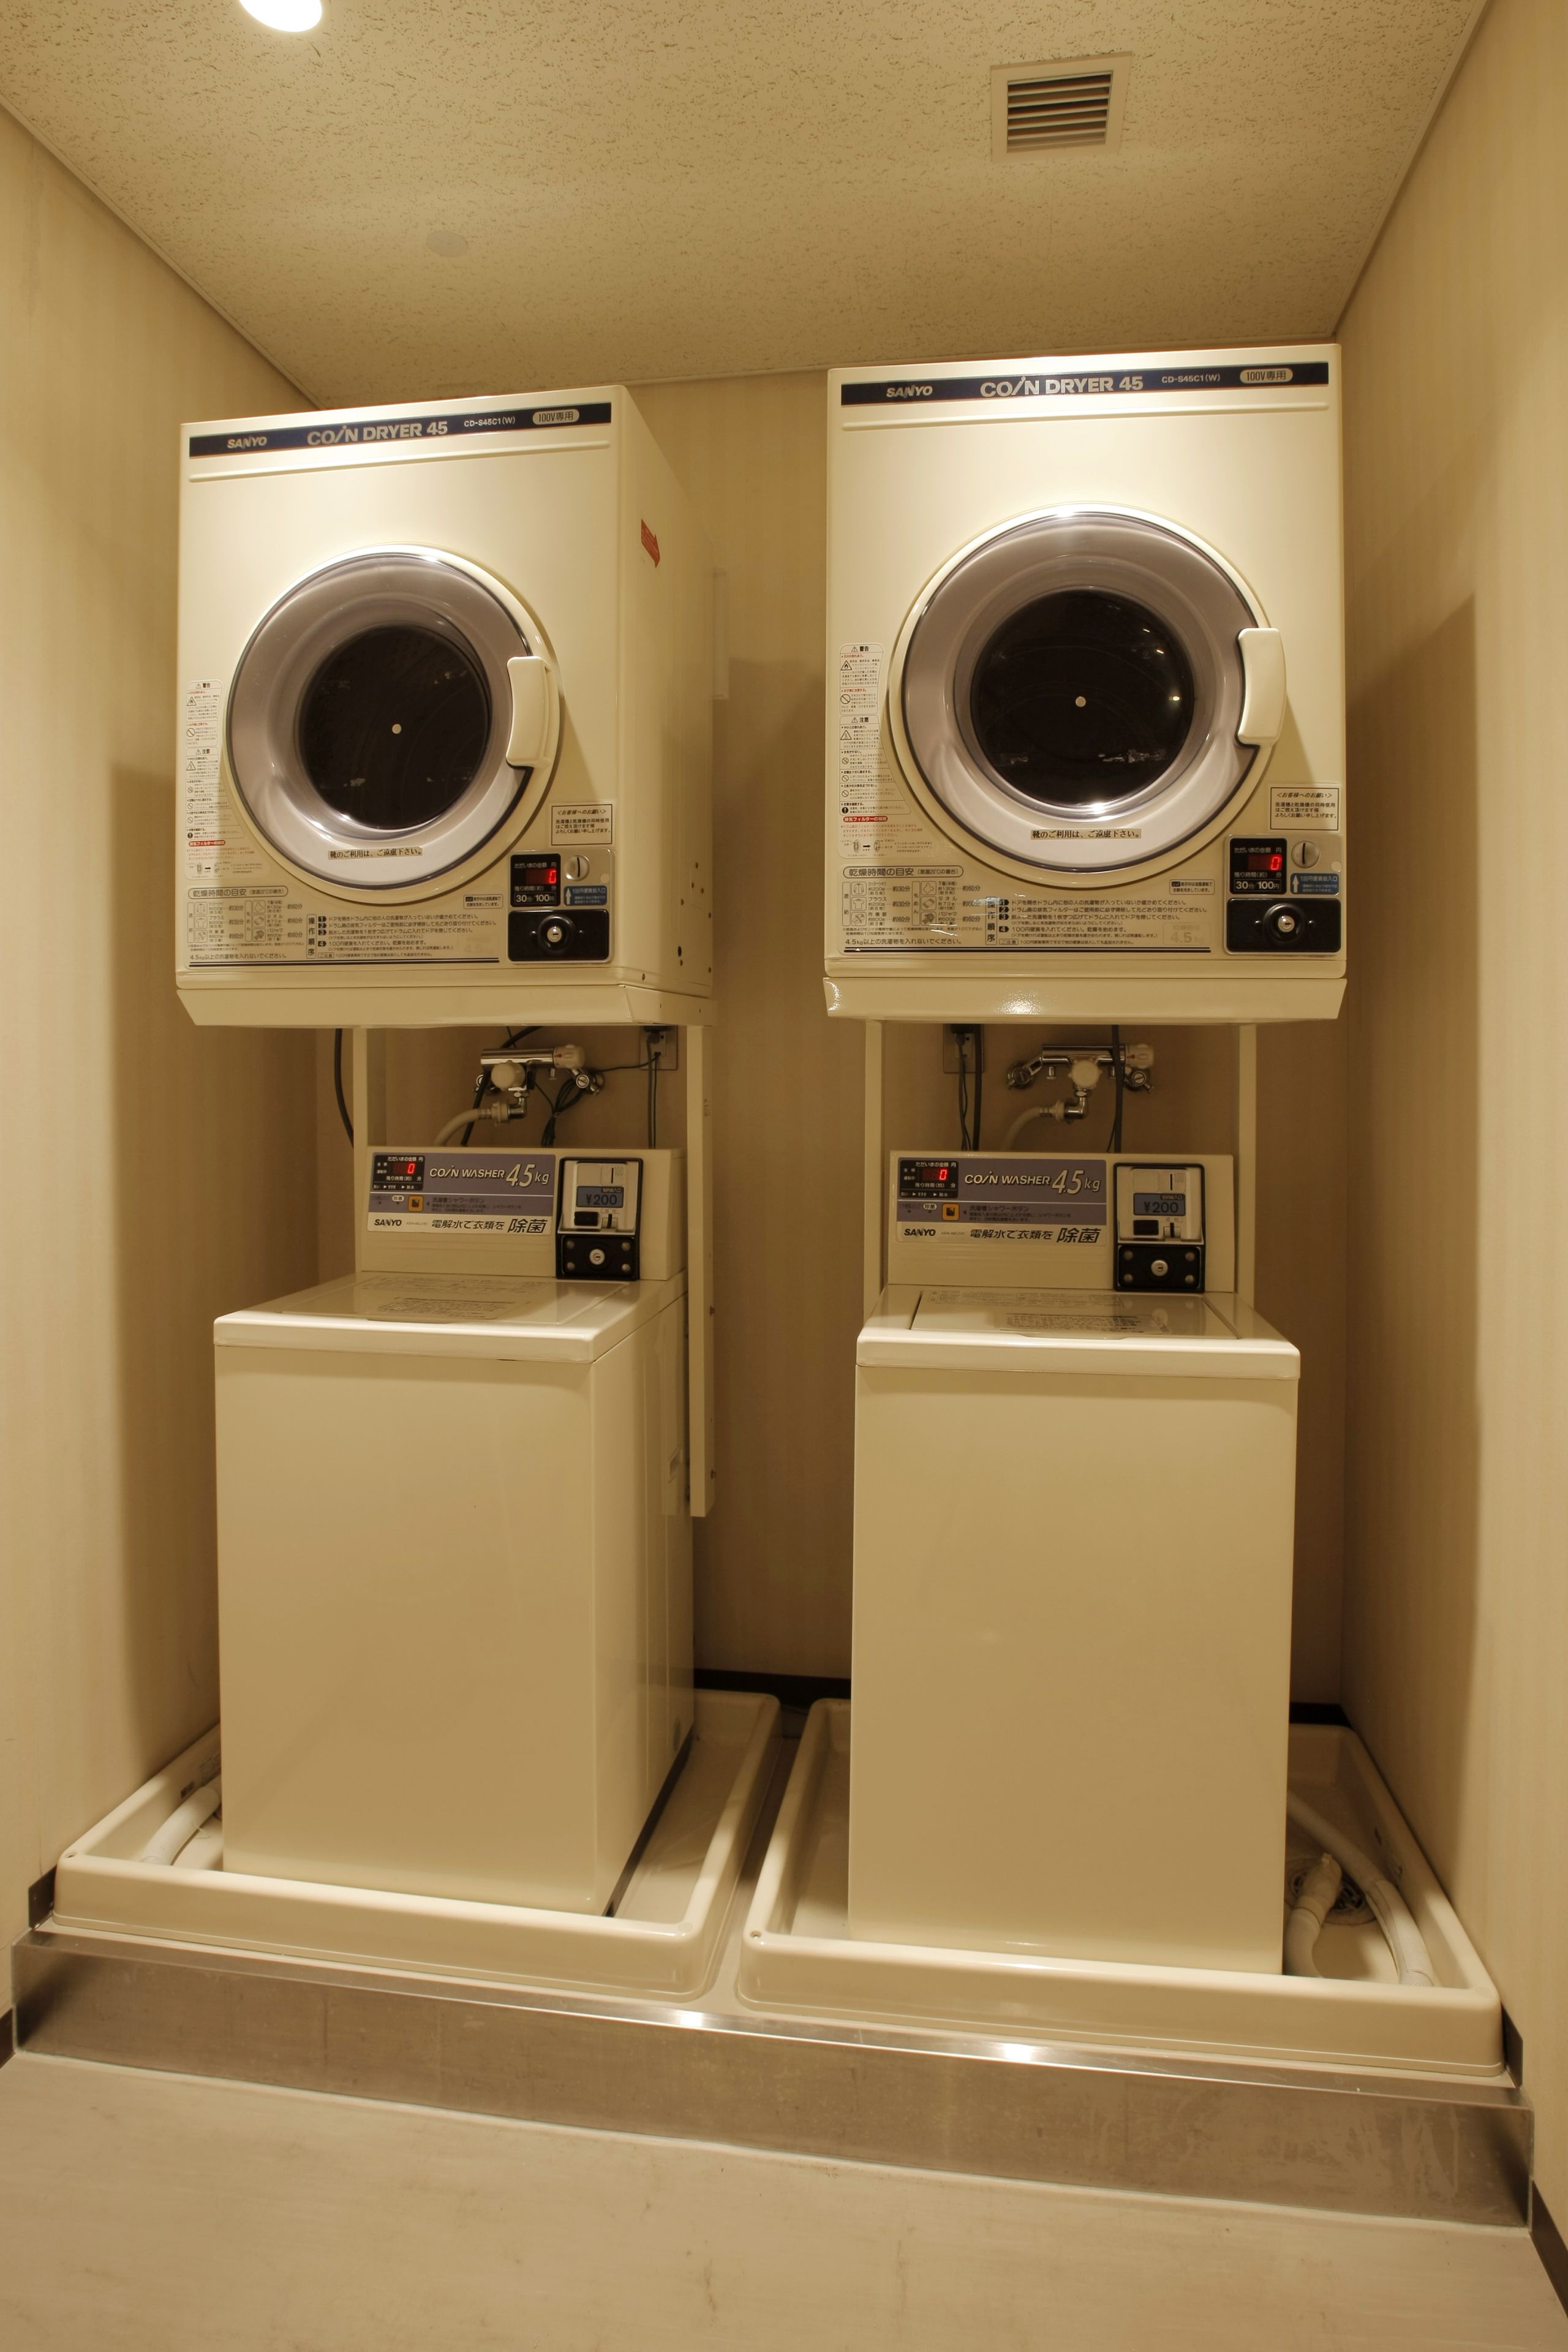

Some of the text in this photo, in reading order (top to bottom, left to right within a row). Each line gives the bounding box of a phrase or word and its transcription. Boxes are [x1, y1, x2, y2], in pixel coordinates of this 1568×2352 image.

[1045, 377, 1114, 394] DRYER
[1119, 375, 1144, 391] 45
[1161, 374, 1221, 383] CD-S45C1(W)
[886, 385, 933, 398] SANYO
[464, 416, 516, 428] CD-S45C1(W)
[363, 423, 423, 441] DRYER
[427, 421, 448, 435] 45
[227, 436, 268, 449] SANYO
[1271, 856, 1281, 870] 0
[549, 870, 557, 883] 0
[849, 867, 914, 877] 乾燥時間の目安
[193, 889, 247, 897] 乾燥時間の目安
[407, 1163, 415, 1174] 0
[462, 1169, 505, 1178] WASHER
[939, 1169, 948, 1181] 0
[1001, 1175, 1050, 1185] WASHER
[586, 1194, 617, 1205] ¥200
[1142, 1201, 1178, 1213] ¥200
[432, 1218, 548, 1234] 電解水で衣類を 除菌
[904, 1227, 936, 1237] SANYO
[970, 1227, 1101, 1243] 電解水で衣類を 除菌
